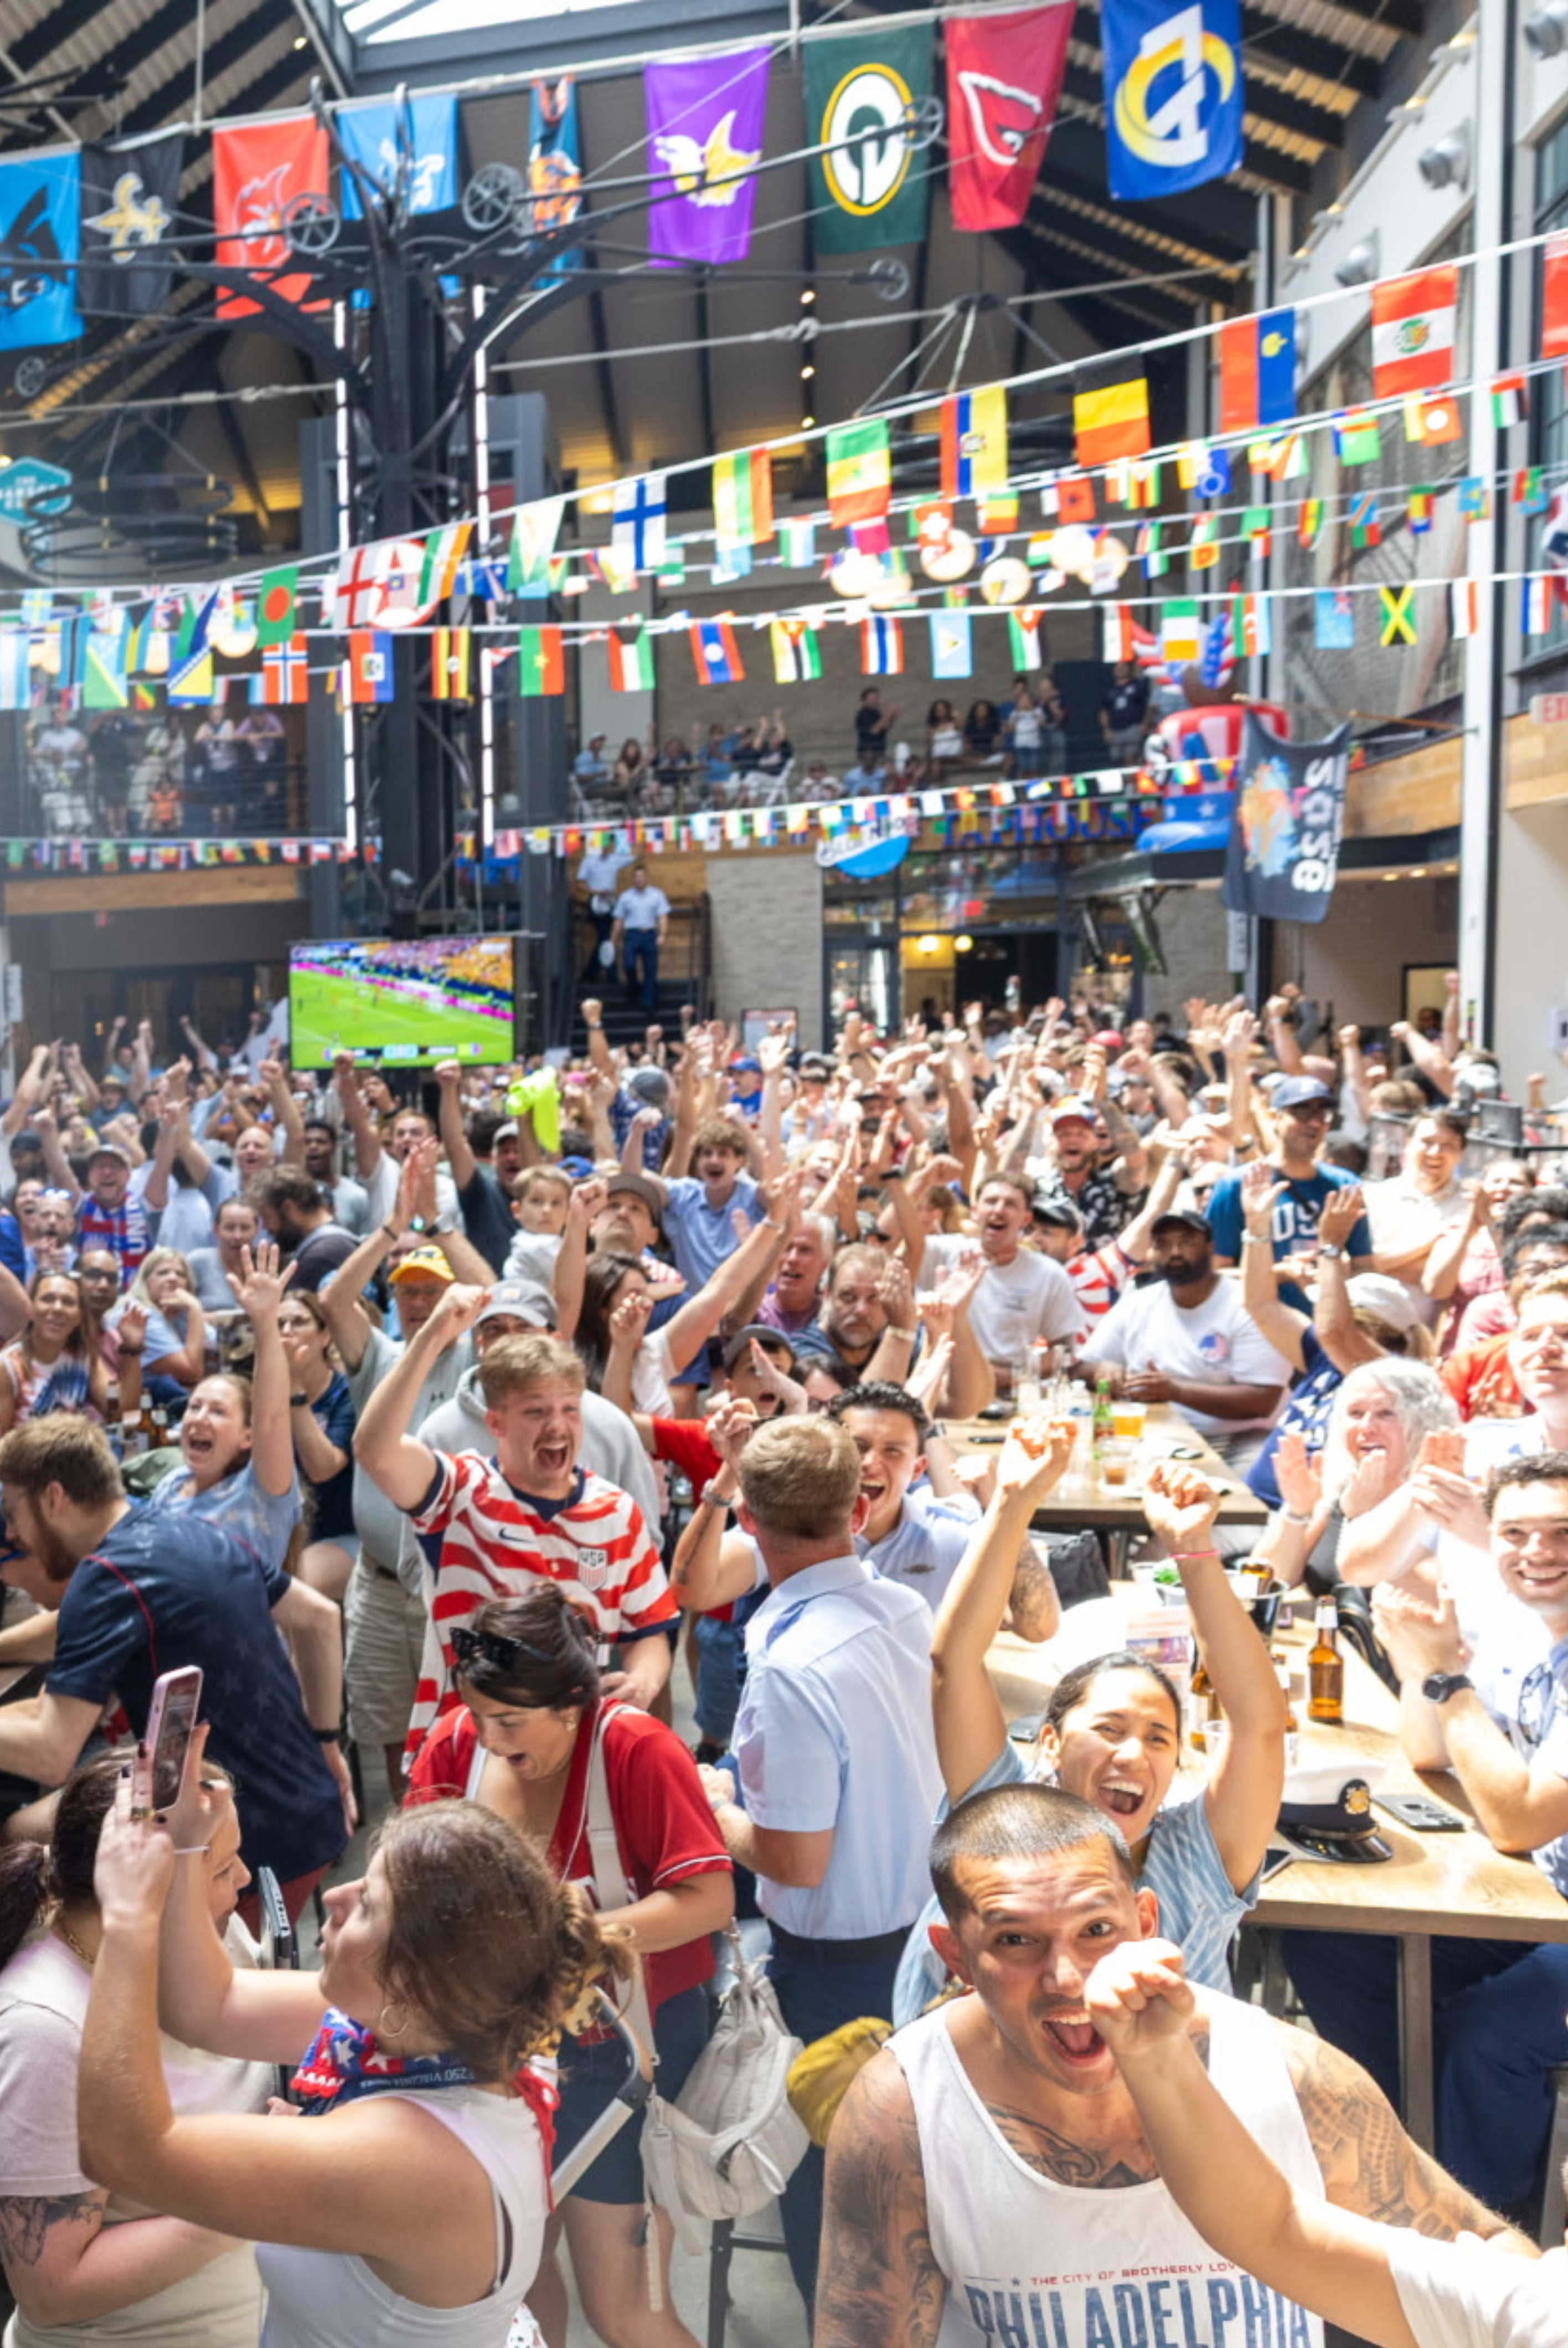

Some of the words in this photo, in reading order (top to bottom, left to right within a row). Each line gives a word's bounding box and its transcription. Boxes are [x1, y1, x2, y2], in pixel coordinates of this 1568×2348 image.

[1542, 695, 1568, 723] EX
[1272, 1199, 1320, 1242] US
[579, 1551, 605, 1567] USA
[393, 2072, 442, 2087] VIRGINIA
[1030, 2276, 1058, 2286] THE
[1063, 2273, 1092, 2283] CITY
[1098, 2271, 1115, 2280] OF
[1122, 2264, 1203, 2278] BROTHERLY
[1209, 2262, 1235, 2273] LOV
[964, 2274, 1311, 2348] PHILADELPHIA
